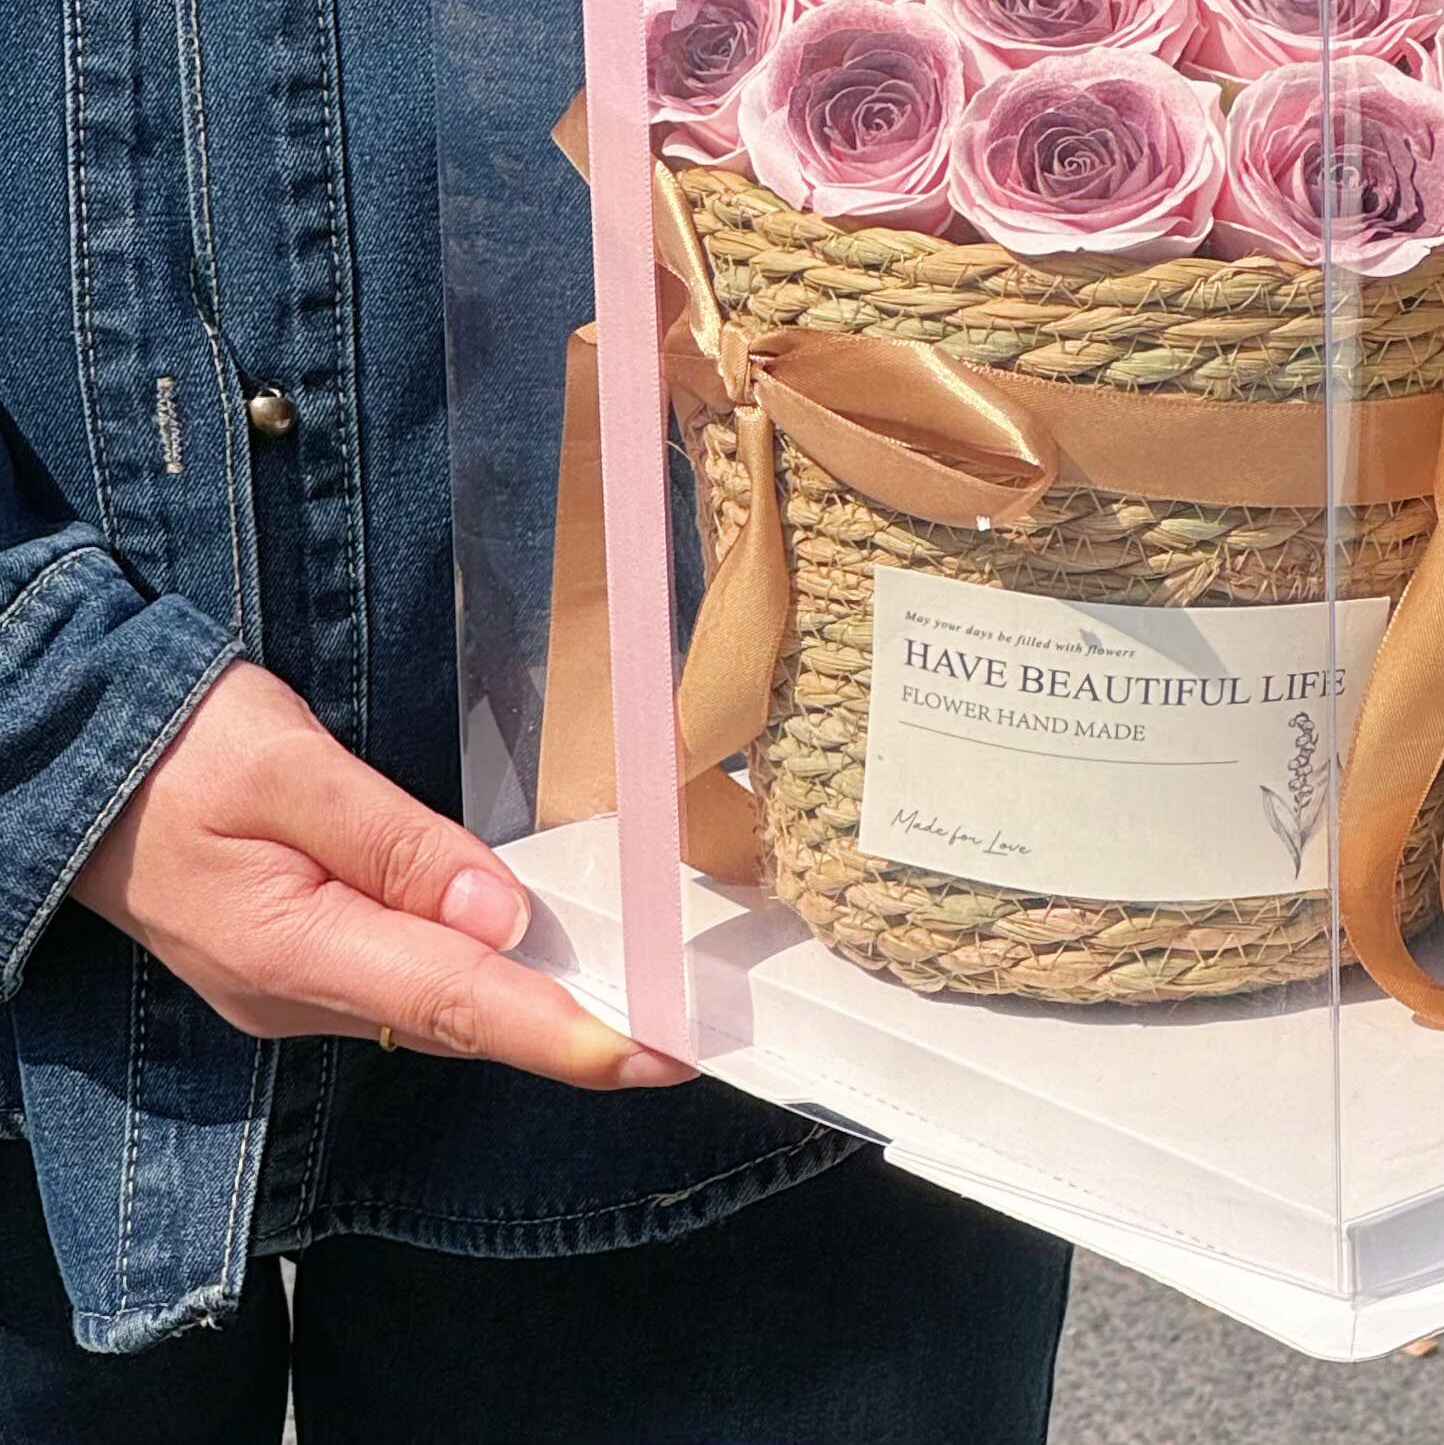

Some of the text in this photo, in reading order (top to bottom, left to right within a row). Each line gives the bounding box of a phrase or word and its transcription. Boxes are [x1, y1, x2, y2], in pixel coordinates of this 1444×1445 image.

[904, 610, 1136, 659] May your days be filled with flowers
[902, 638, 1346, 707] HAVE BEAUTIFUL LIFE
[900, 684, 1147, 743] FLOWER HAND MADE
[890, 808, 1032, 856] Made for Love
